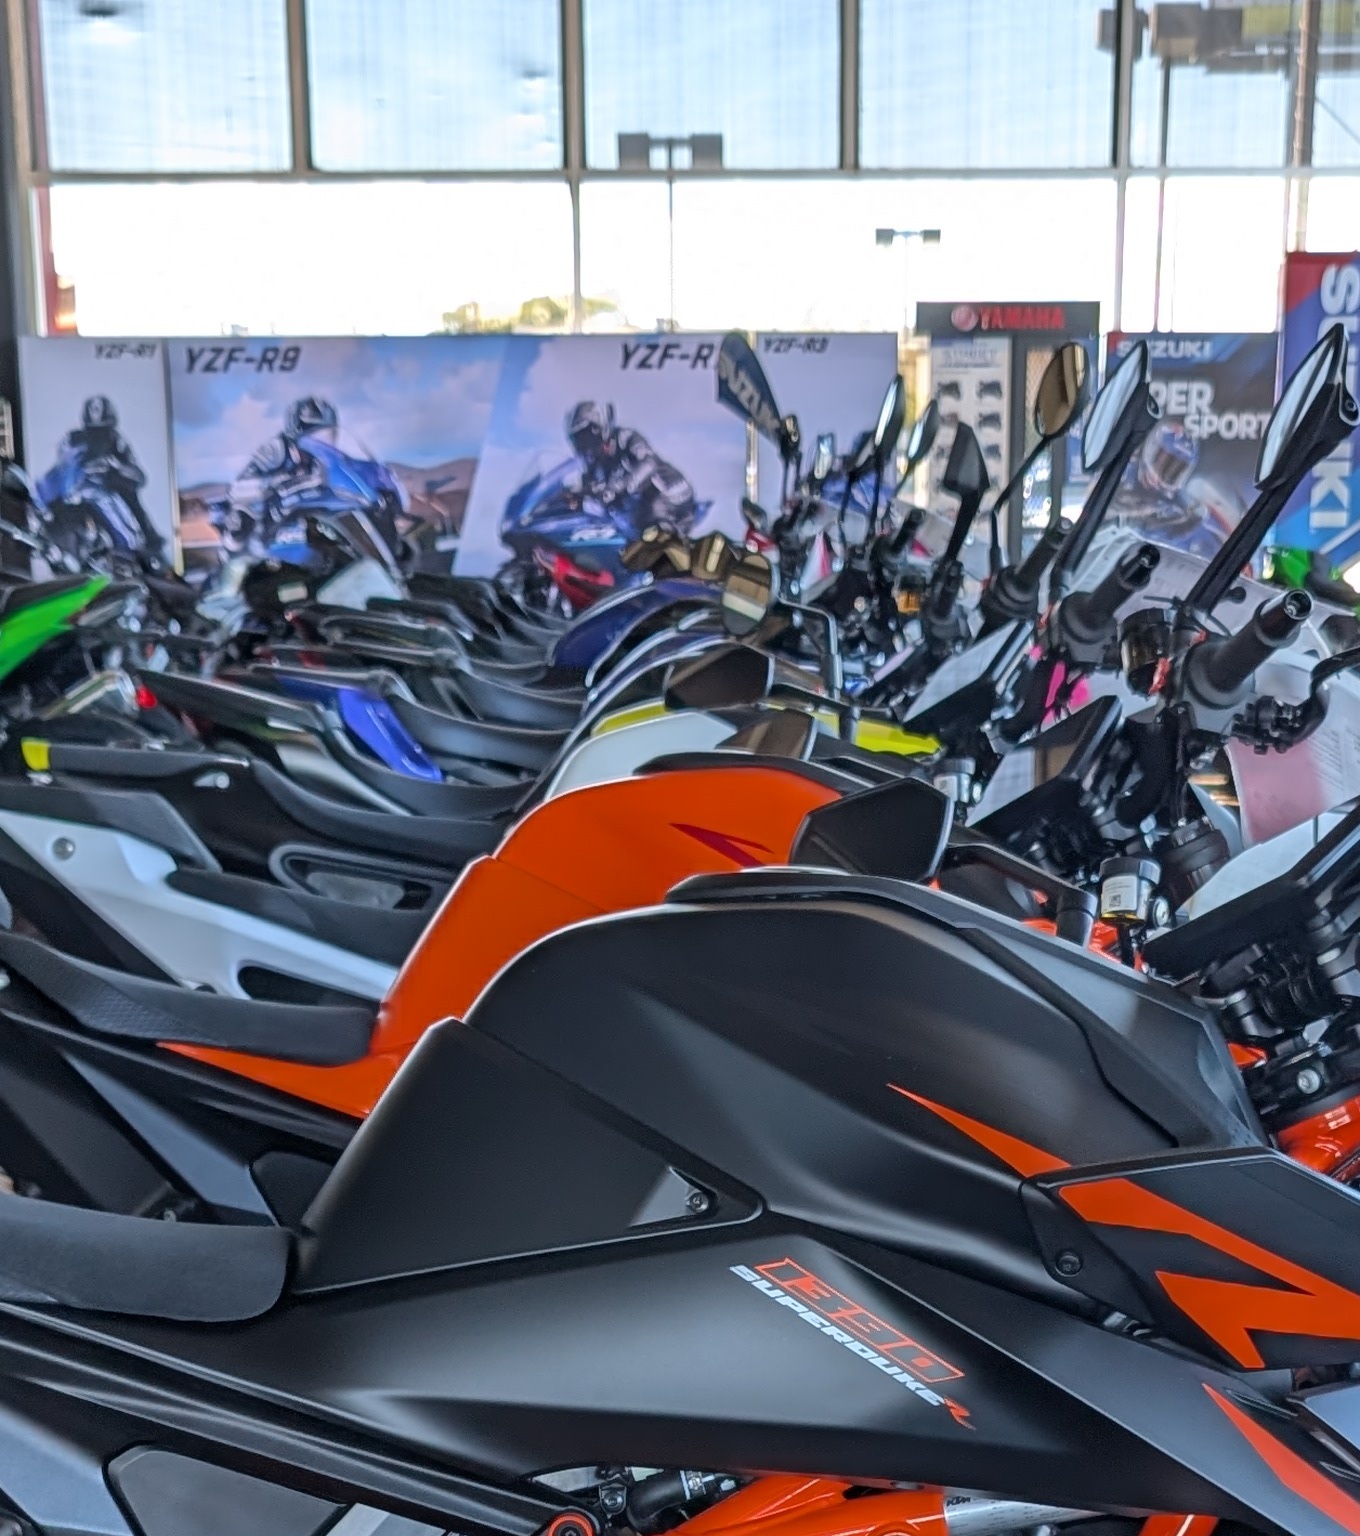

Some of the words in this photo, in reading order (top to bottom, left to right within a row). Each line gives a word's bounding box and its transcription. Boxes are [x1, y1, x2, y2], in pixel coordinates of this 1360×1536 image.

[979, 305, 1066, 331] YAMAHA
[184, 346, 303, 374] YZF-R9
[619, 343, 715, 371] YZF-R
[1148, 380, 1214, 415] PER
[729, 1264, 947, 1407] SUPERDUKE
